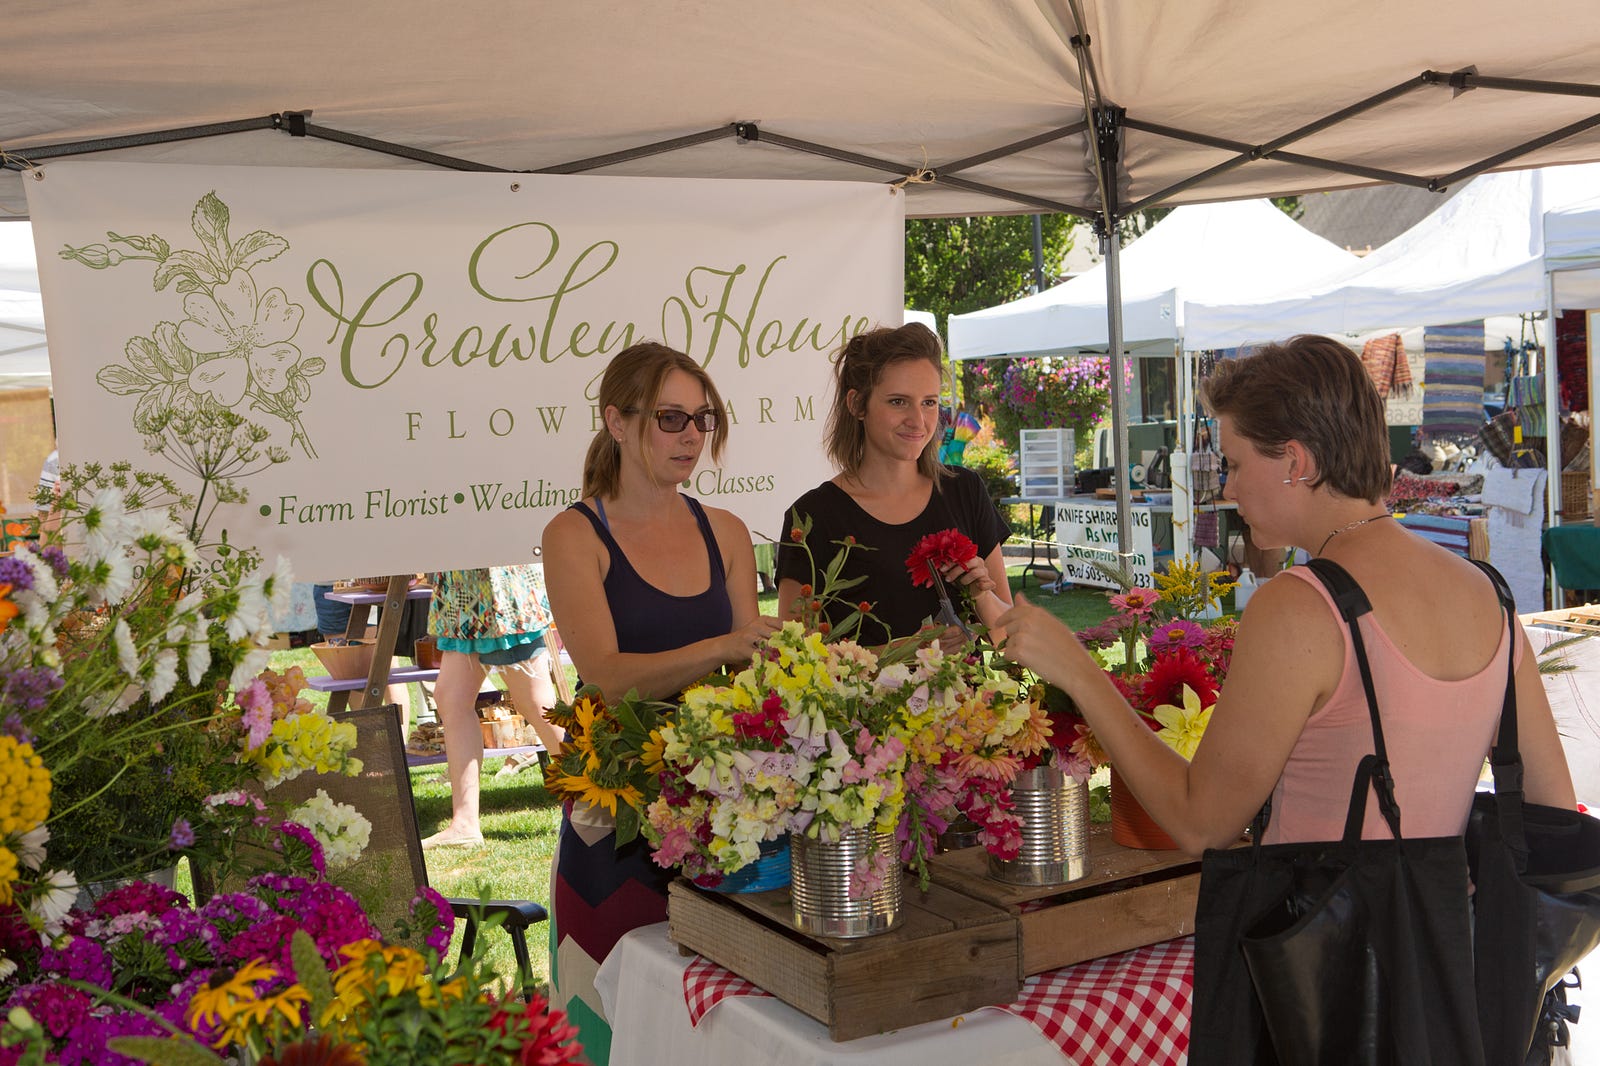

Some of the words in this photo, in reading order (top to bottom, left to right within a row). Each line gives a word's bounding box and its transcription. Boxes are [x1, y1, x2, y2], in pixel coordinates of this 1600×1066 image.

[306, 222, 645, 401] Crowley
[662, 255, 869, 370] House
[406, 404, 604, 441] FLOWE
[725, 395, 816, 425] ARM
[277, 495, 355, 525] Farm
[364, 488, 449, 520] Florist
[696, 468, 775, 496] Classes
[1057, 508, 1084, 524] KNIFE
[1085, 510, 1149, 527] SHARPING
[1085, 527, 1100, 543] As
